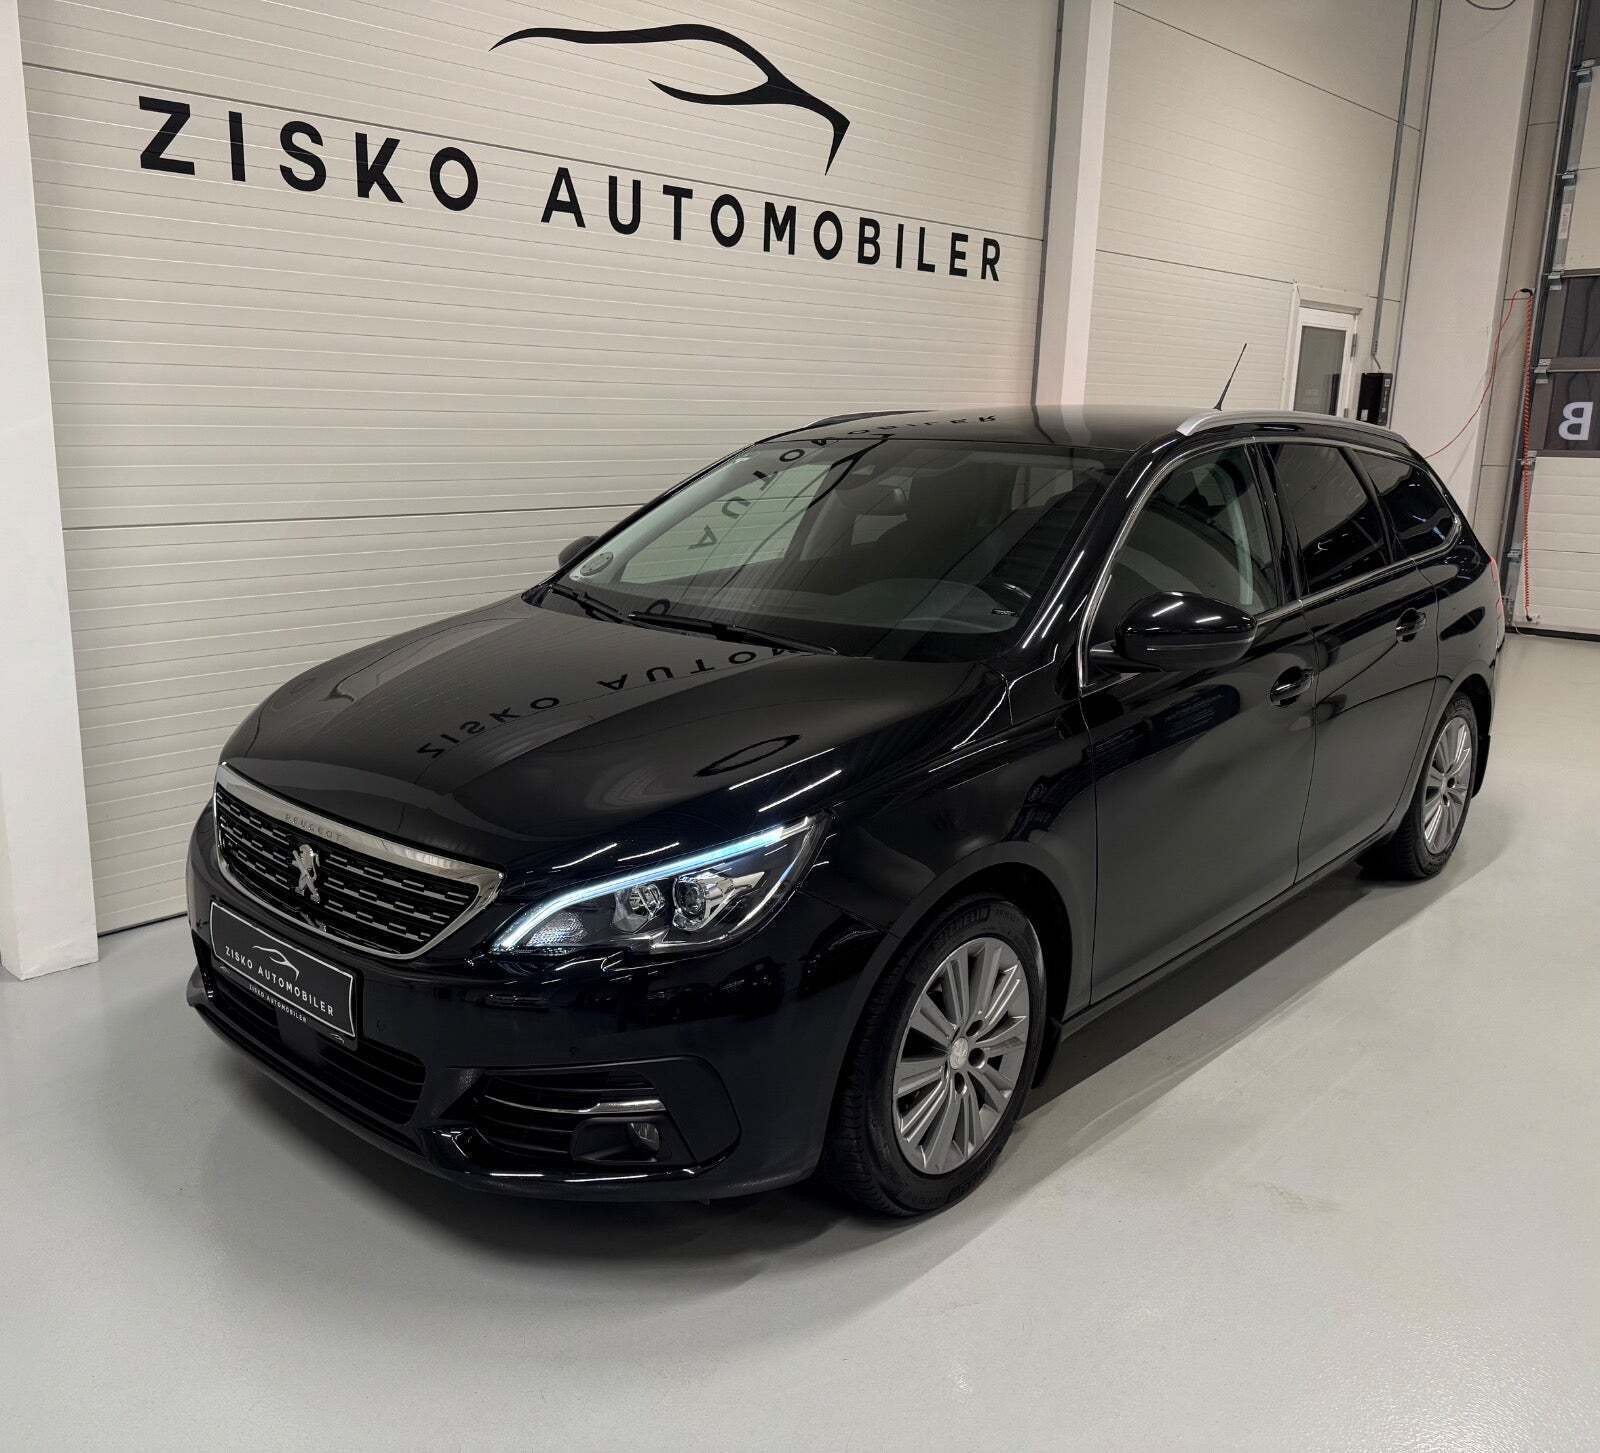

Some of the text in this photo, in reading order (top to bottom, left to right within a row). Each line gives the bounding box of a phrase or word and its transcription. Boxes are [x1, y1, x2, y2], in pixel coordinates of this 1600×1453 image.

[138, 95, 1001, 282] ZISKO AUTOMOBILER
[225, 945, 334, 1017] ZISKO AUTOMOBILER
[266, 995, 307, 1023] AUTOMOBILER
